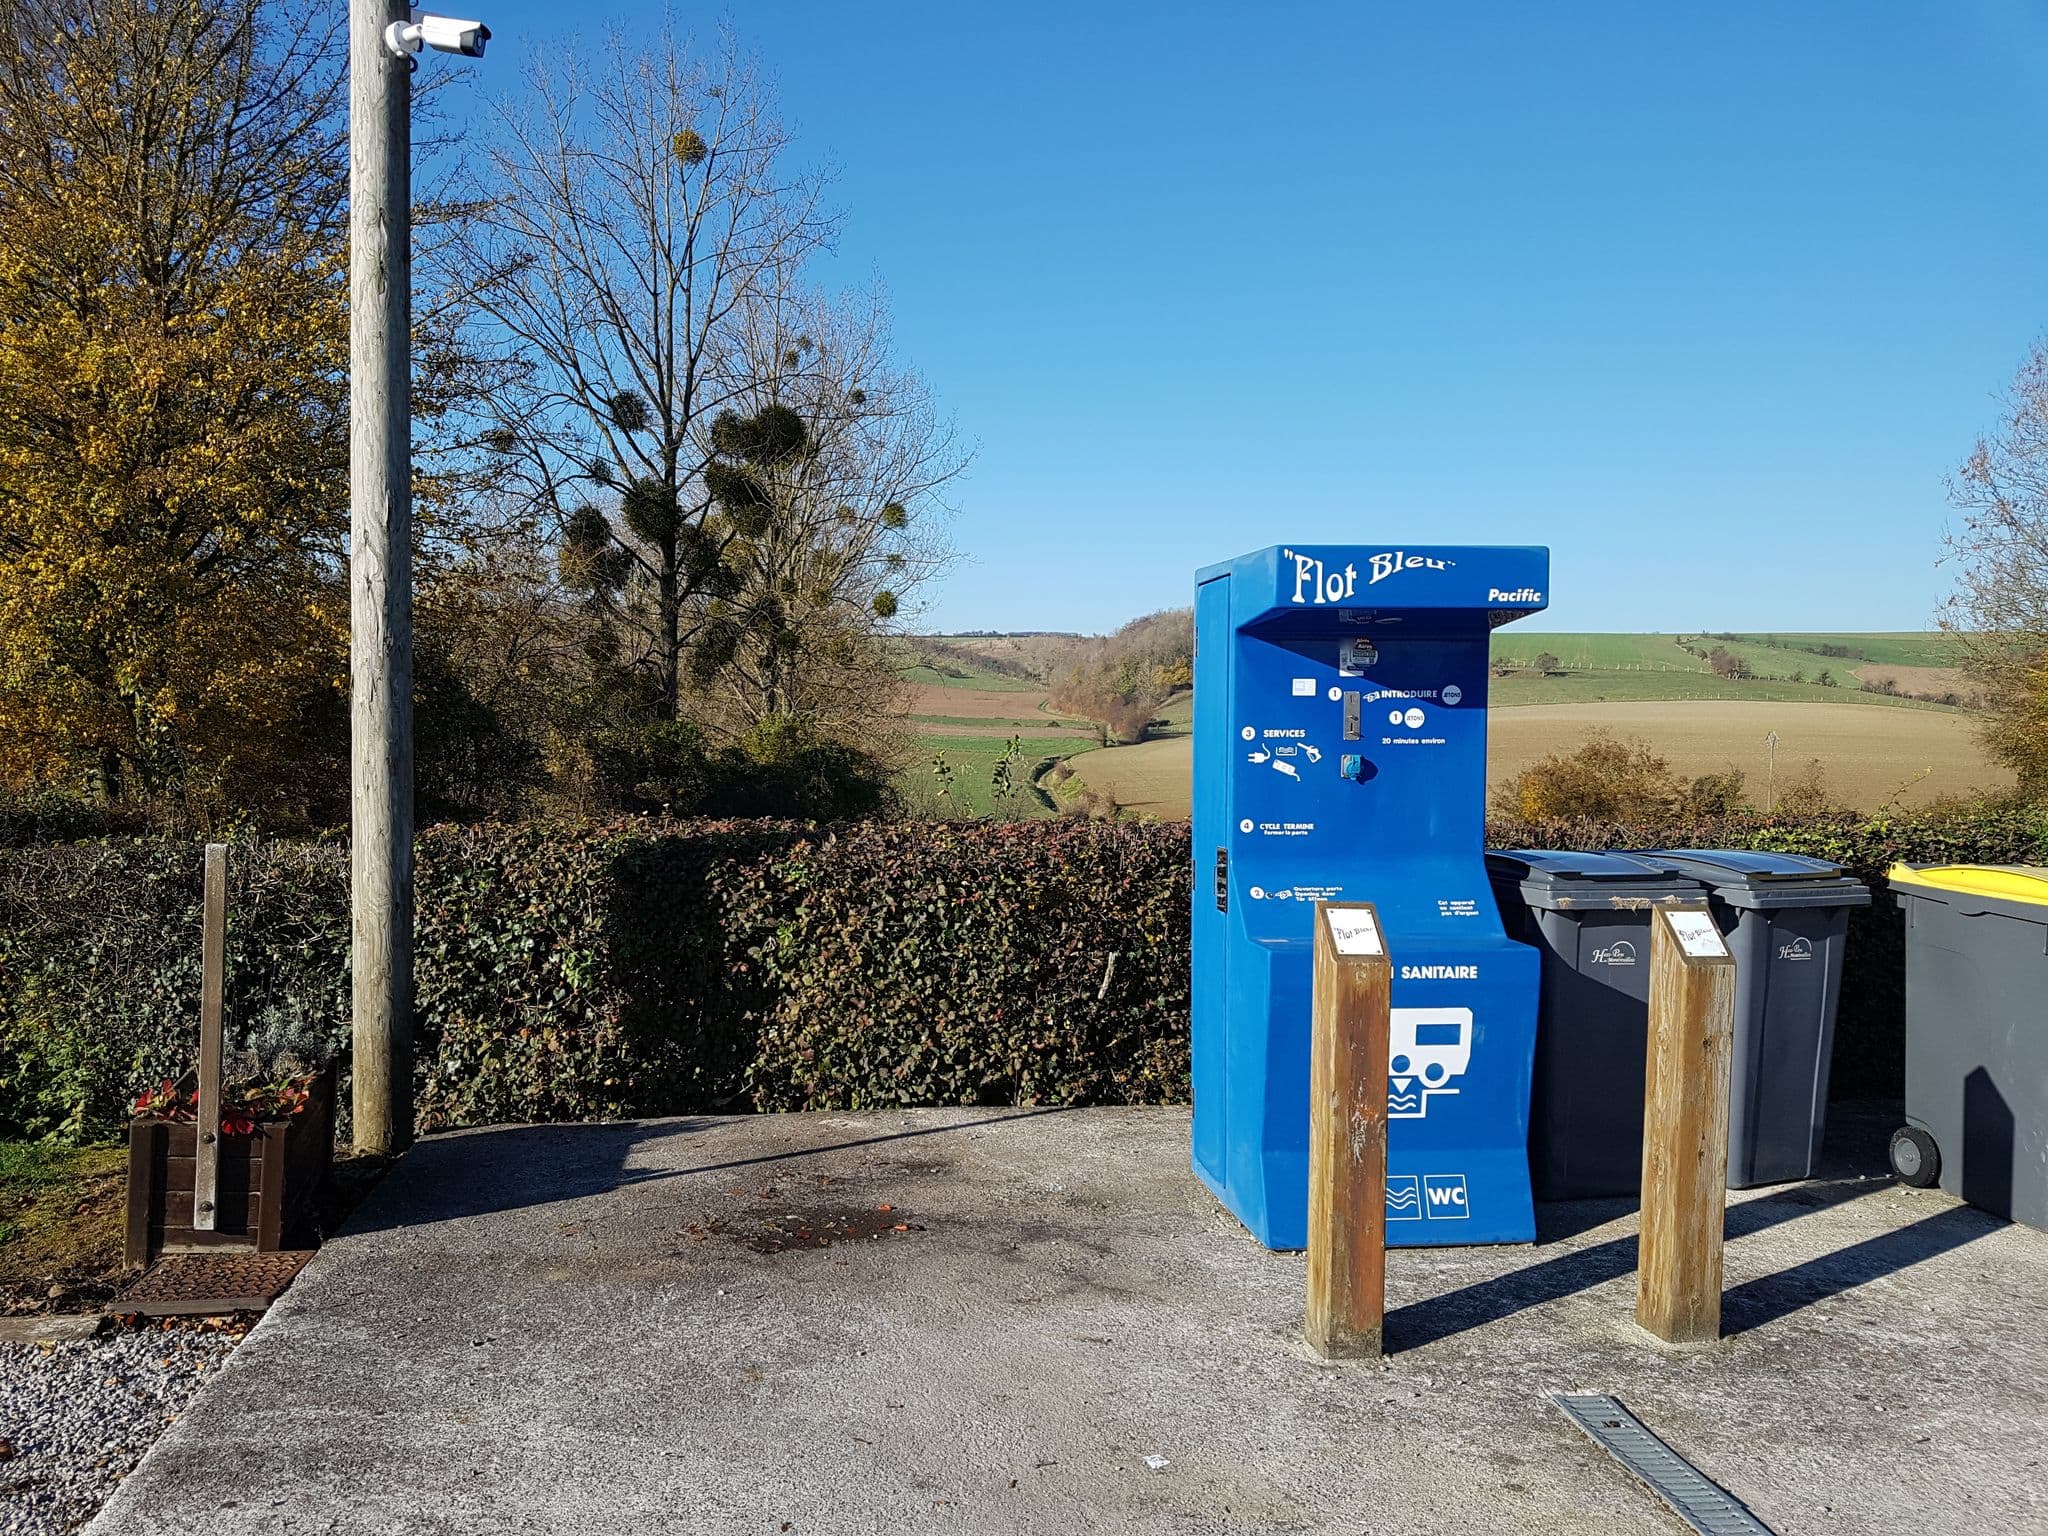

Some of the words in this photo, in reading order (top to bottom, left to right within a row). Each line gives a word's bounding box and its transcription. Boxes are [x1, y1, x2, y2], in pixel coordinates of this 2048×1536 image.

[1488, 588, 1541, 602] Pacific
[1381, 690, 1438, 699] INTRODUIRE
[1263, 729, 1306, 738] SERVICES
[1401, 966, 1478, 979] SANITAIRE
[1428, 1187, 1464, 1205] WC
